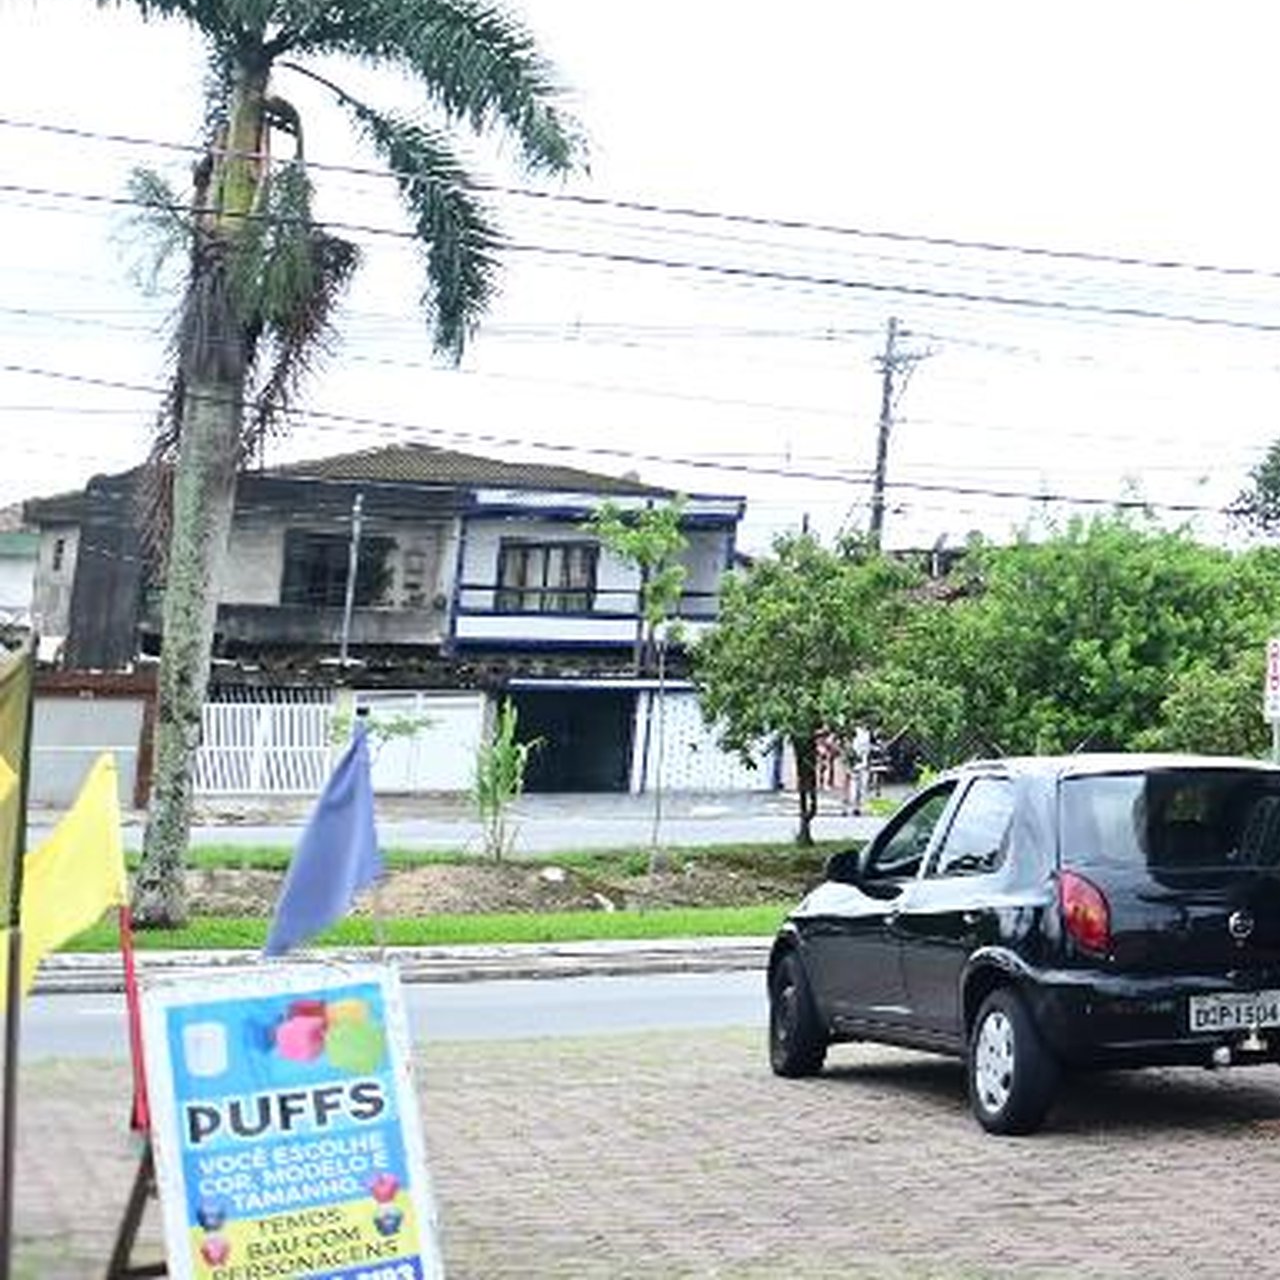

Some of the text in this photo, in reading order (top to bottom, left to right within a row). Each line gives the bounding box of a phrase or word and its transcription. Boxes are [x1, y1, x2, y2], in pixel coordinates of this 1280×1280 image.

[186, 1081, 385, 1145] PUFFS
[198, 1129, 386, 1176] VOCÊ ESCOLHE
[264, 1154, 368, 1186] MODELO
[372, 1147, 390, 1168] E
[305, 1225, 362, 1250] COM
